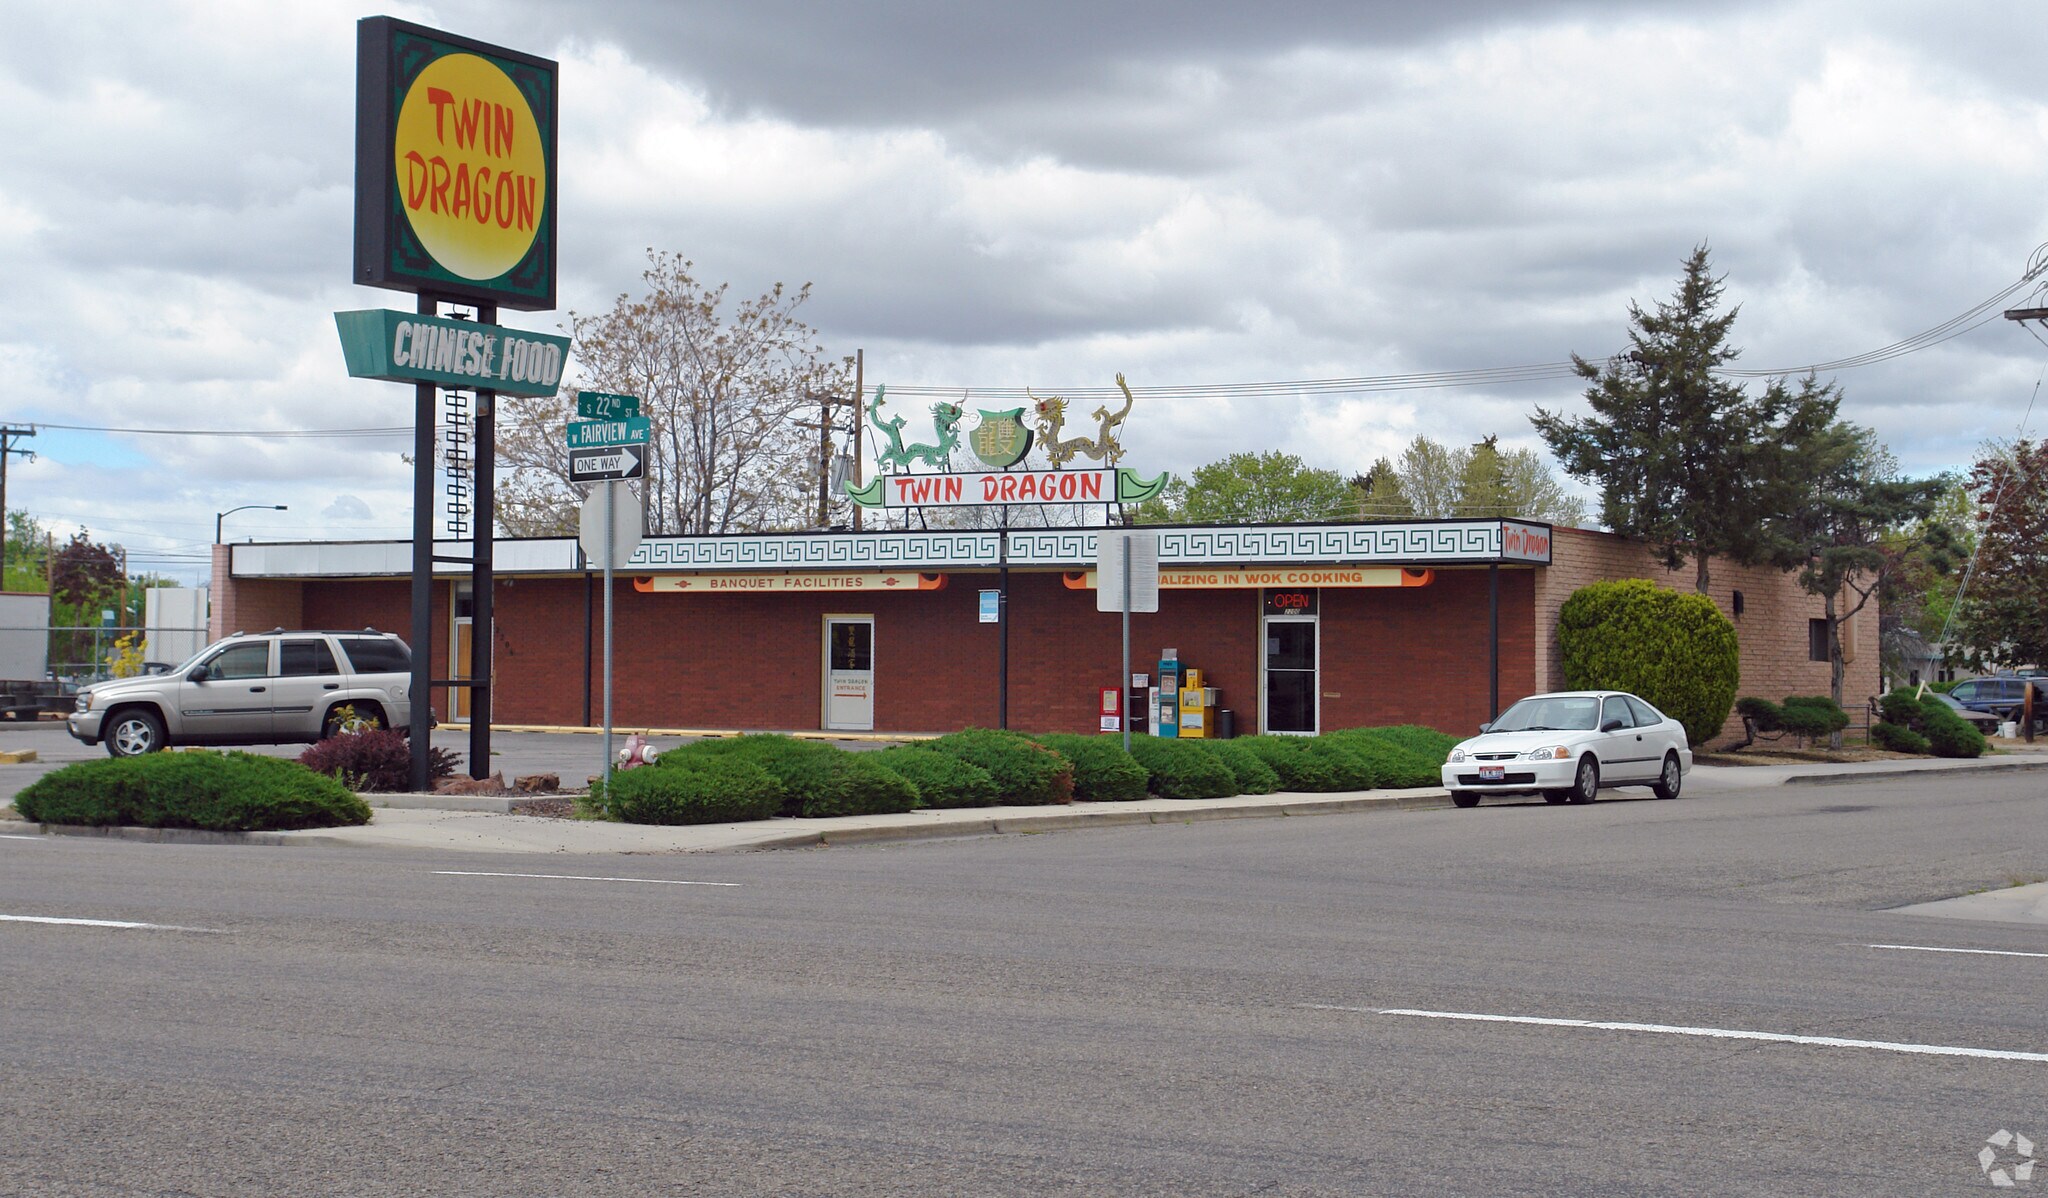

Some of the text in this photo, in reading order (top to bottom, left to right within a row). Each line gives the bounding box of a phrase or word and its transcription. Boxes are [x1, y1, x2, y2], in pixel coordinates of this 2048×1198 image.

[427, 86, 514, 160] TWIN
[404, 150, 536, 233] DRAGON
[393, 320, 562, 386] CHINESE FOOD
[587, 396, 632, 418] S 22ND ST
[572, 422, 644, 444] W FAIRVIEW AVE
[577, 456, 621, 471] ONE WAY
[895, 472, 1103, 504] TWIN DRAGON
[1503, 526, 1548, 556] Twin Dragon
[710, 577, 863, 589] BANQUET FACILITIES
[1224, 574, 1239, 584] IN
[1245, 573, 1282, 584] WOK
[1287, 572, 1363, 583] COOKING
[1274, 593, 1309, 608] OPEN
